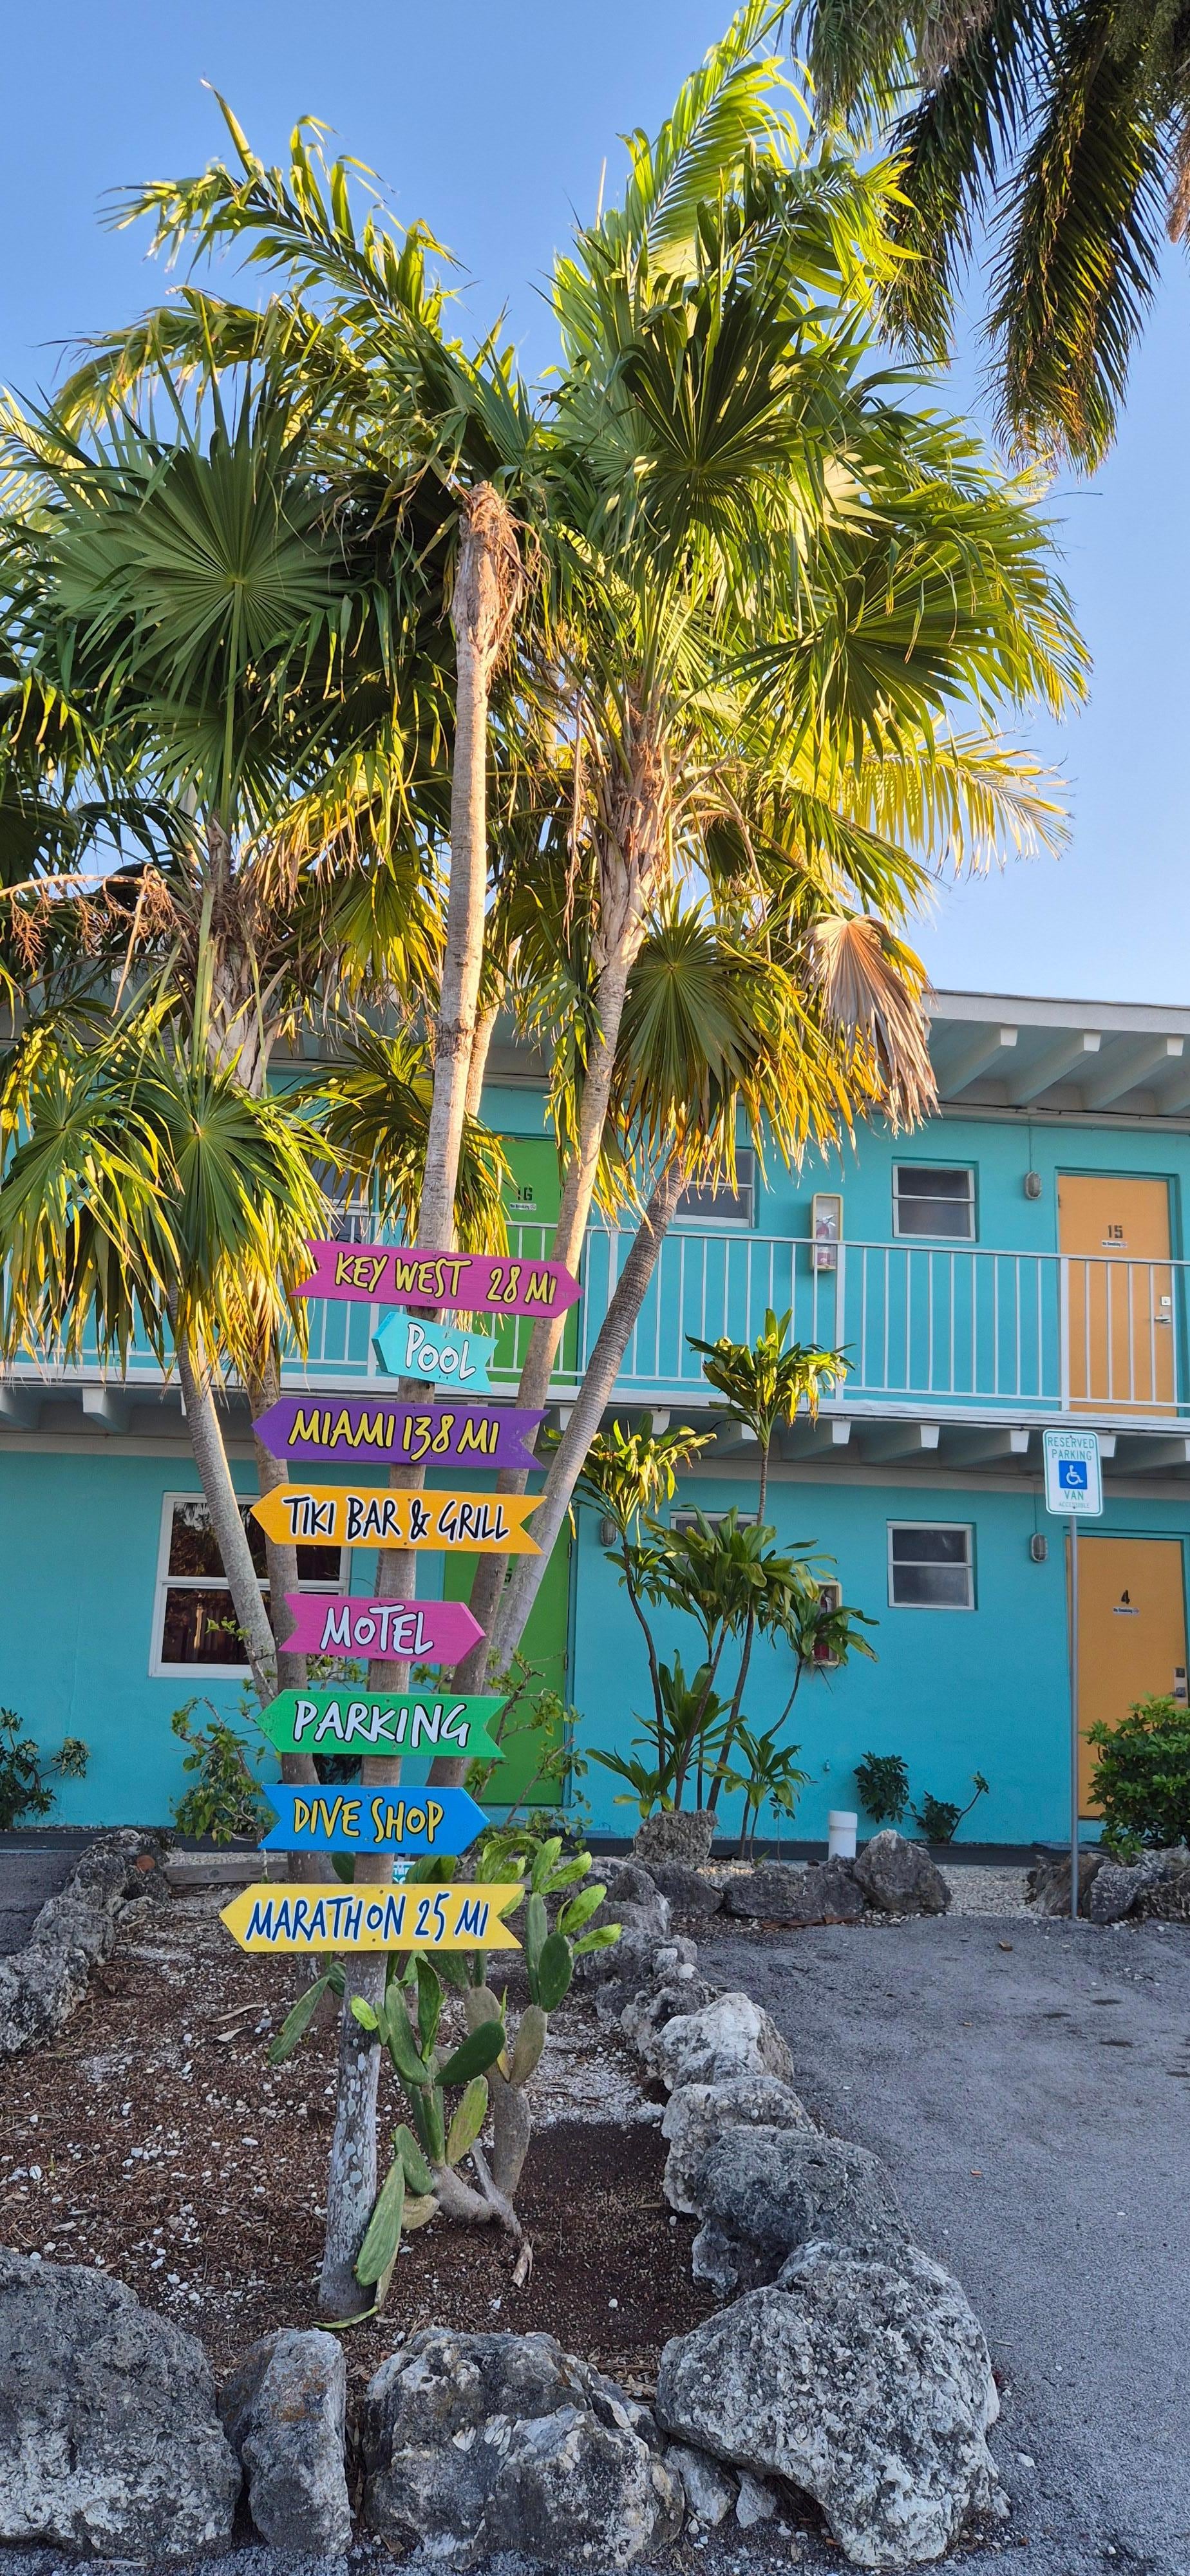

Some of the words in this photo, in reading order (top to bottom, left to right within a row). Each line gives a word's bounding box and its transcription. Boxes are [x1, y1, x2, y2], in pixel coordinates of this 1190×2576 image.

[1108, 1225, 1123, 1238] 15
[335, 1251, 388, 1293] KEY
[395, 1256, 473, 1298] WEST
[487, 1264, 522, 1303] 28
[524, 1270, 558, 1305] MI
[406, 1321, 477, 1381] POOL
[287, 1408, 396, 1448] MIAMI
[402, 1413, 455, 1461] 138
[457, 1417, 500, 1454] MI
[1048, 1436, 1095, 1448] RESERVED
[1052, 1449, 1092, 1461] PARKING
[282, 1494, 336, 1537] TIKI
[346, 1495, 402, 1541] BAR
[409, 1497, 433, 1541] &
[437, 1500, 511, 1542] GRILL
[1064, 1490, 1084, 1501] VAN
[1120, 1589, 1130, 1604] 4
[320, 1604, 434, 1654] MOTEL
[293, 1700, 471, 1748] PARKING
[293, 1796, 362, 1839] DIVE
[370, 1797, 444, 1844] SHOP
[245, 1894, 407, 1942] MARATHON
[415, 1891, 450, 1942] 25
[453, 1899, 489, 1938] MI
